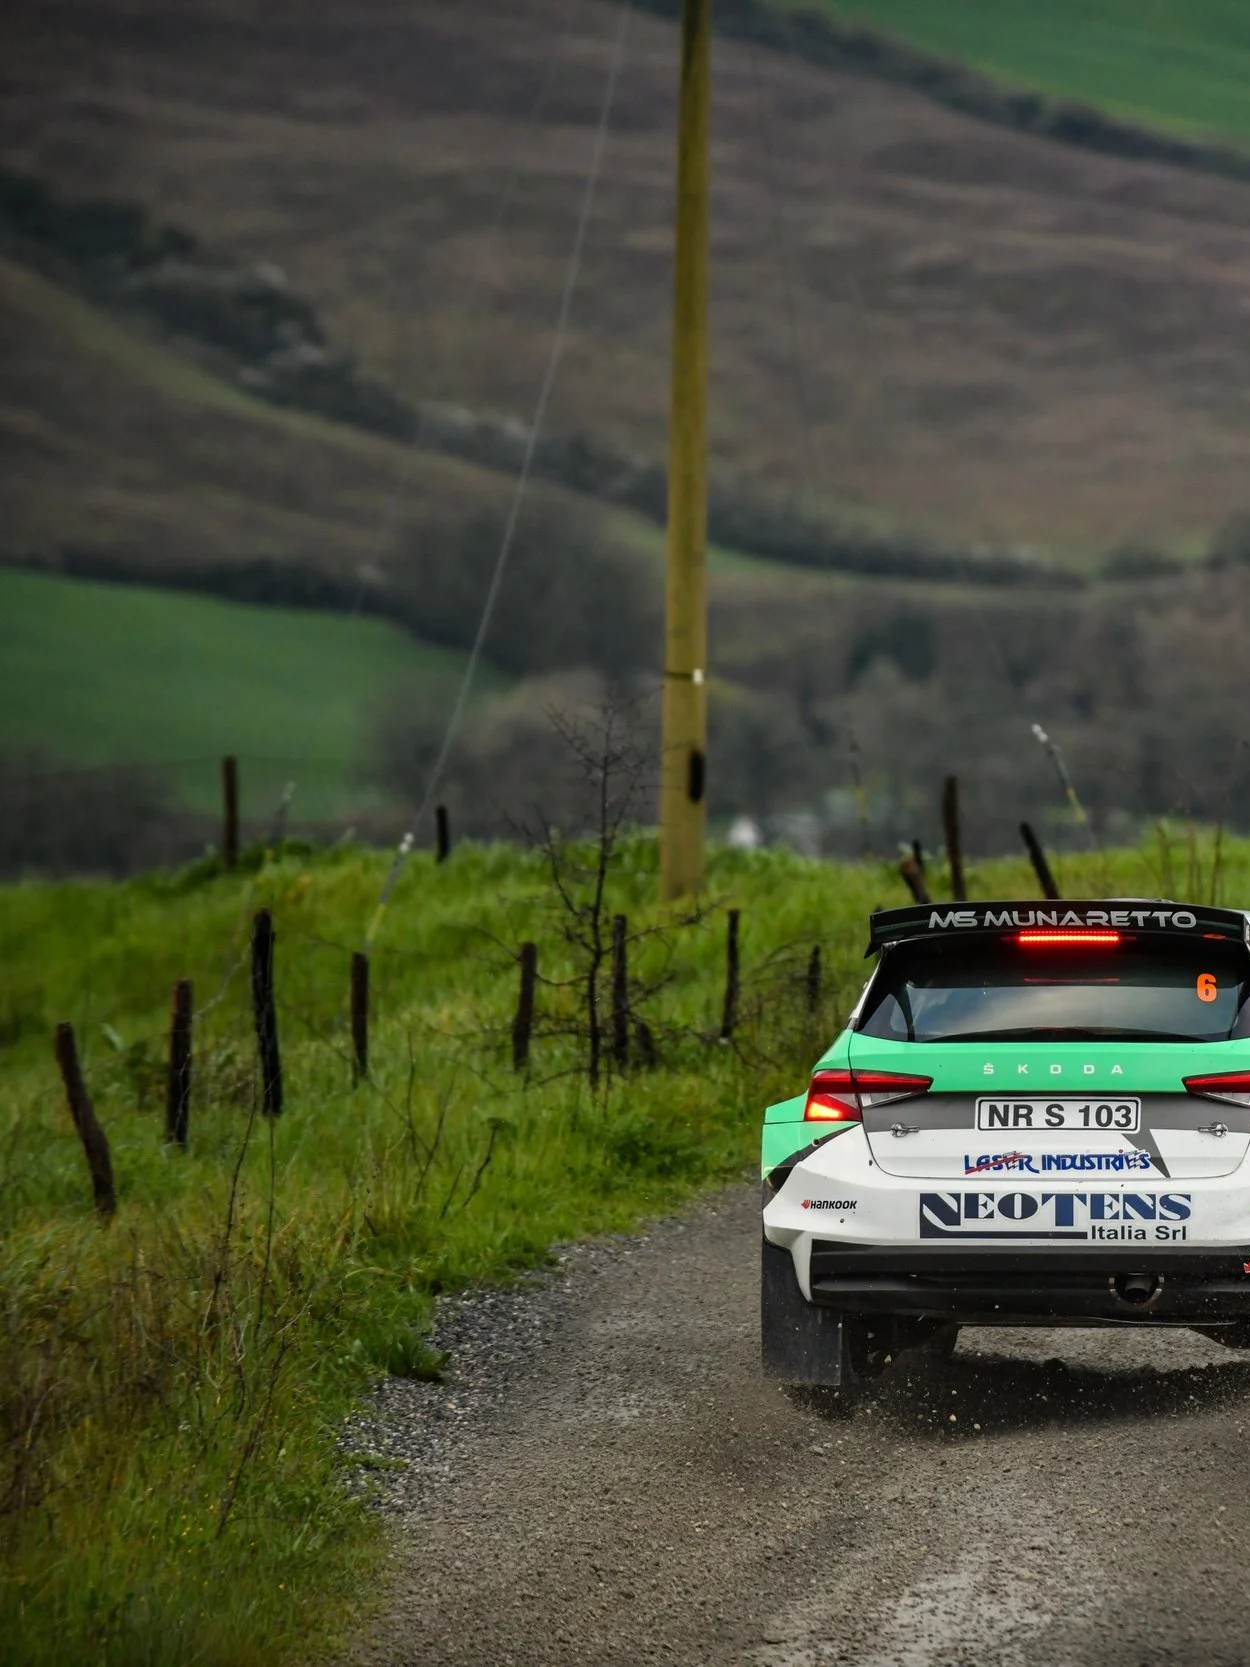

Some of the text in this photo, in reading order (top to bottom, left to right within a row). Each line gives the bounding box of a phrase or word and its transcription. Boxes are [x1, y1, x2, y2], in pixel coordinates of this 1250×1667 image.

[928, 910, 1197, 928] MS MUNARETTO
[1197, 973, 1217, 1002] 6
[988, 1103, 1132, 1128] NR S 103
[919, 1193, 1192, 1228] NEOTENS
[1091, 1225, 1187, 1240] Italia Srl
